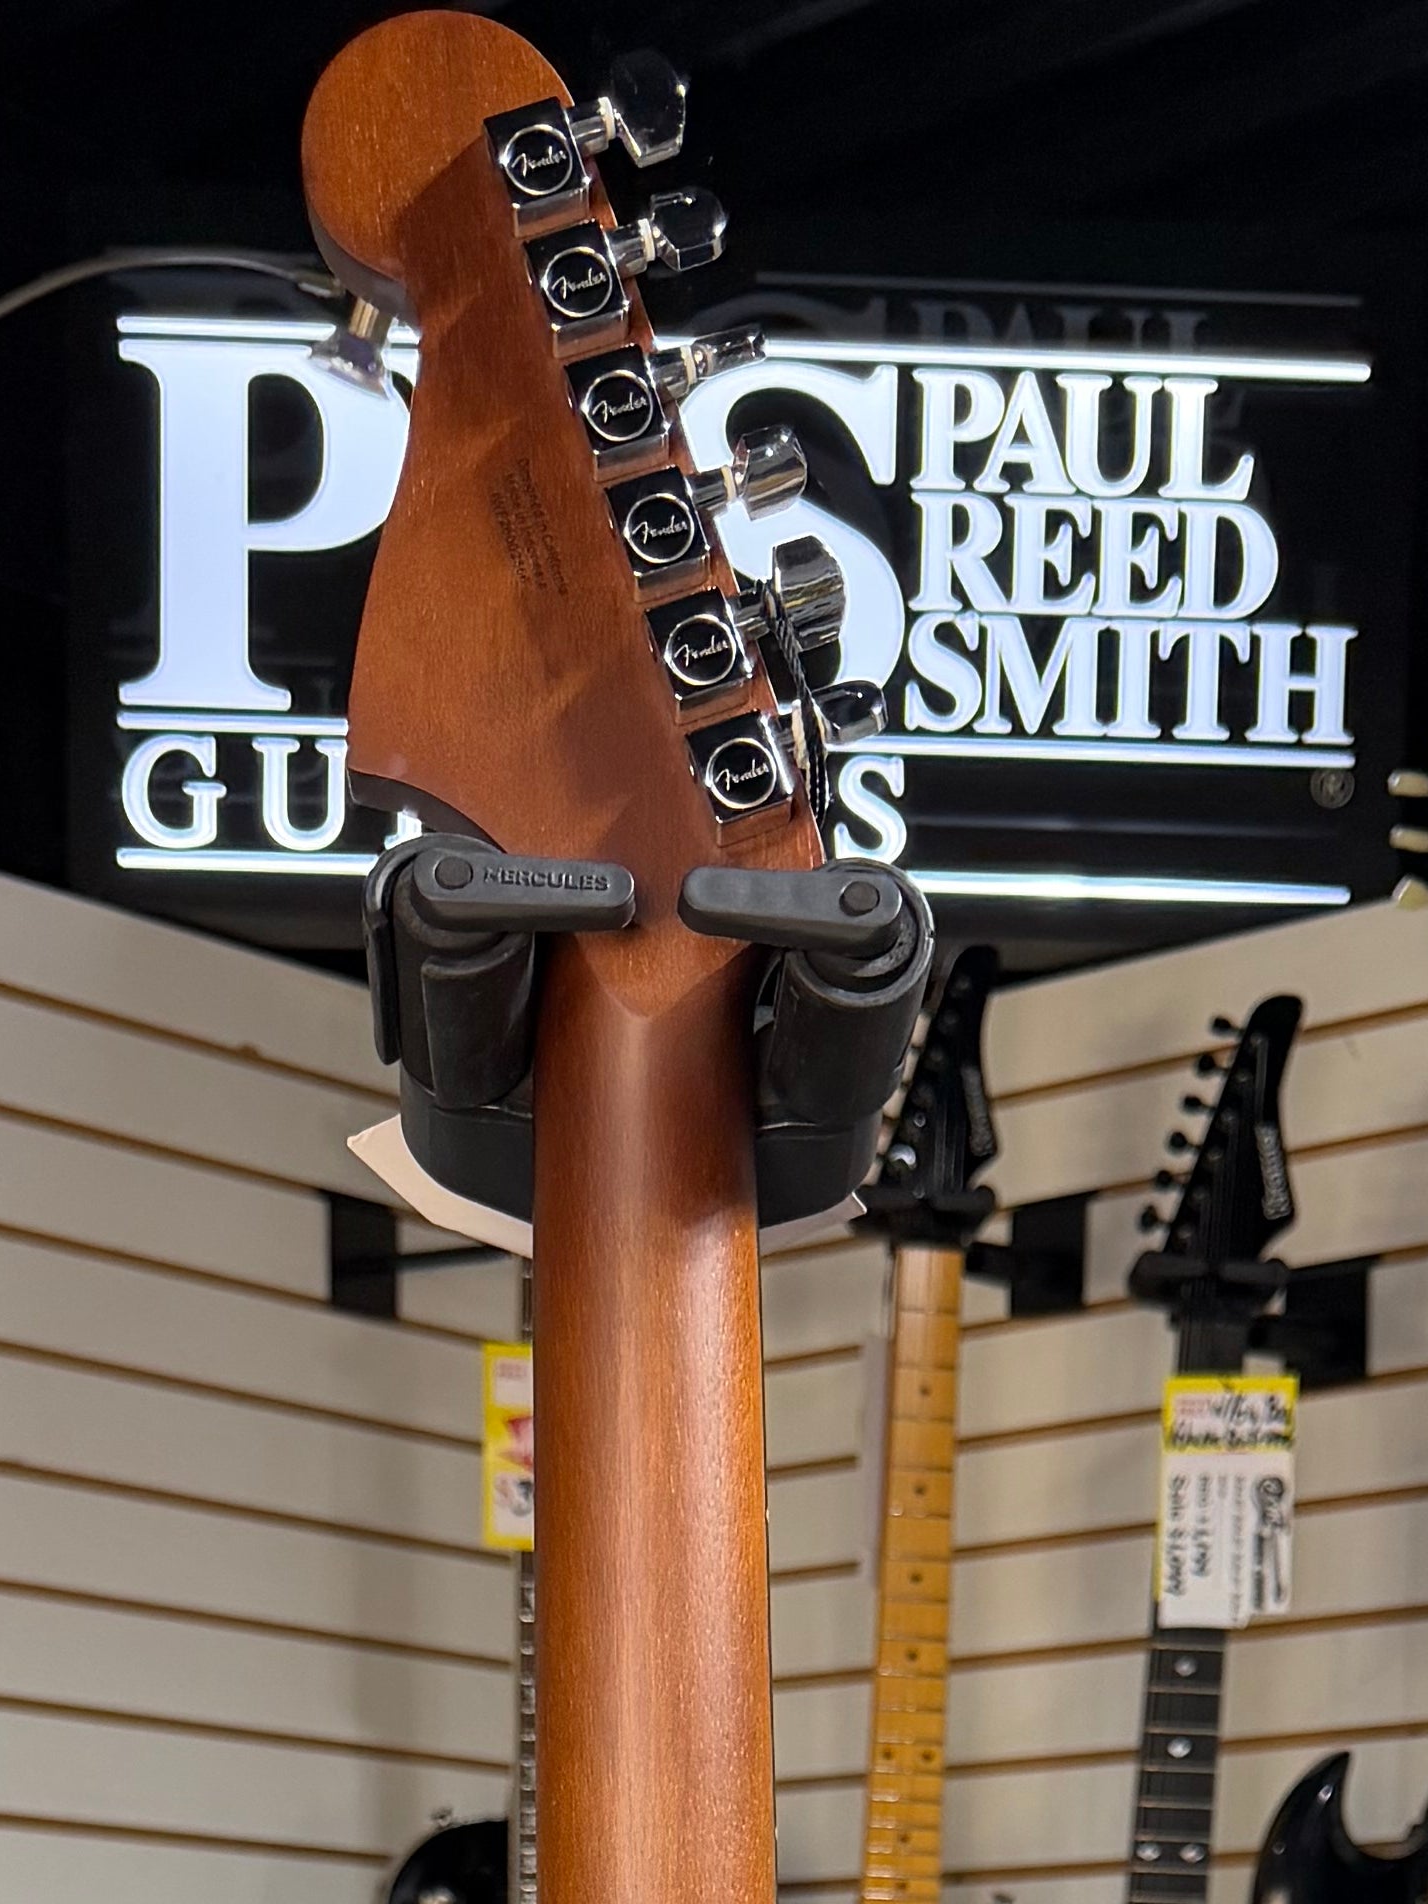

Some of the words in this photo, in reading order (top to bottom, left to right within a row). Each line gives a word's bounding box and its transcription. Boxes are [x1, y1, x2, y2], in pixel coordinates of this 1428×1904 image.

[511, 146, 567, 177] Fender
[552, 267, 608, 300] Fender
[591, 392, 648, 423] Fender
[910, 366, 1256, 502] PAUL
[119, 335, 906, 714] PS
[631, 514, 689, 545] Fender
[910, 490, 1281, 619] REED
[673, 635, 729, 667] Fender
[902, 612, 1360, 746] SMITH
[715, 759, 770, 791] Fender
[483, 866, 611, 892] HERCULES
